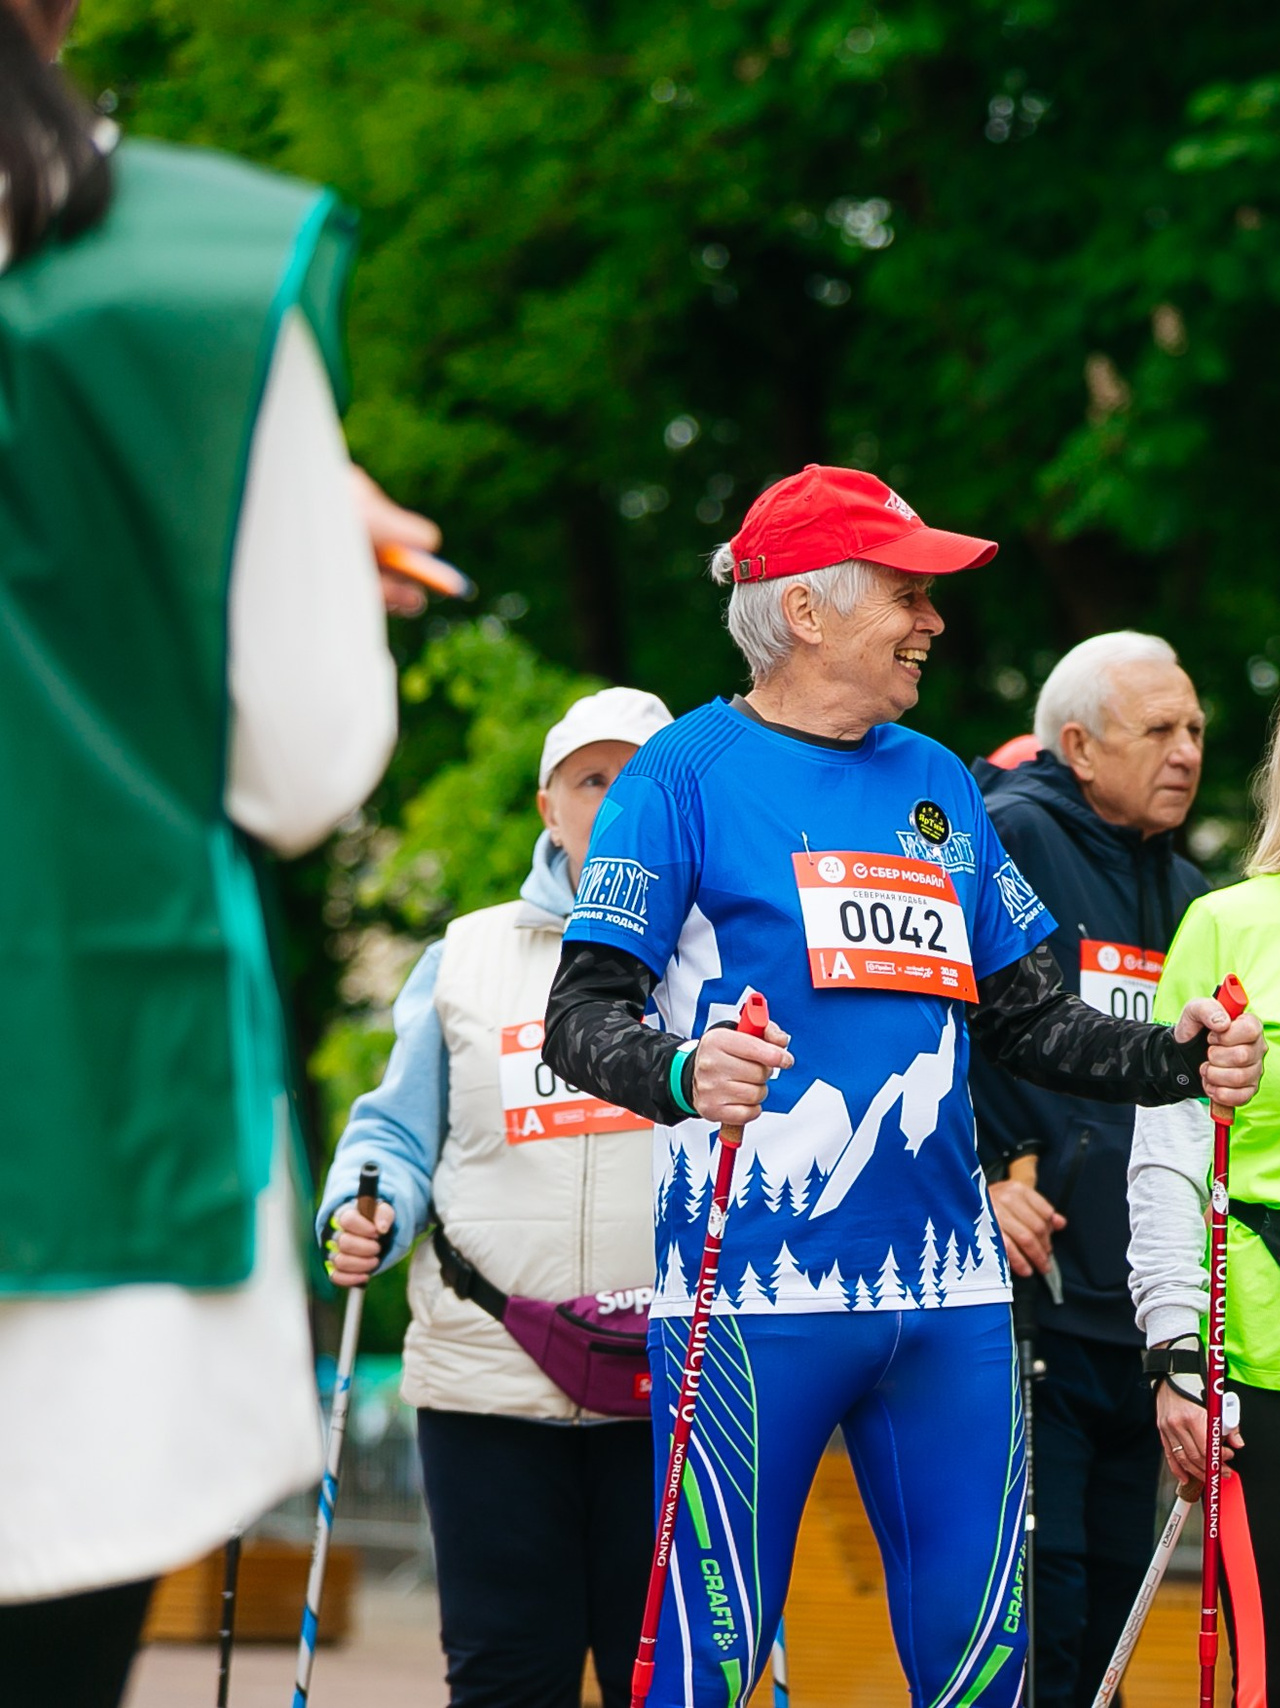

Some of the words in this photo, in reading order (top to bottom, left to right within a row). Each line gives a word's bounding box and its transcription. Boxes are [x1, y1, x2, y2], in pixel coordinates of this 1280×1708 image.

[853, 891, 895, 900] СЕВЕРНАЯ
[898, 896, 927, 905] ХОДЬБА
[869, 867, 900, 879] СБЕР
[901, 870, 945, 888] МОБАЙЛ
[605, 913, 645, 936] ХОДЬБА
[839, 900, 947, 953] 0042
[667, 1443, 685, 1498] NORDIC
[1211, 1416, 1221, 1471] NORDIC
[656, 1500, 676, 1567] WALKING
[1209, 1473, 1219, 1539] WALKING
[701, 1558, 735, 1631] CRAFT
[1003, 1557, 1026, 1634] CRAFT
